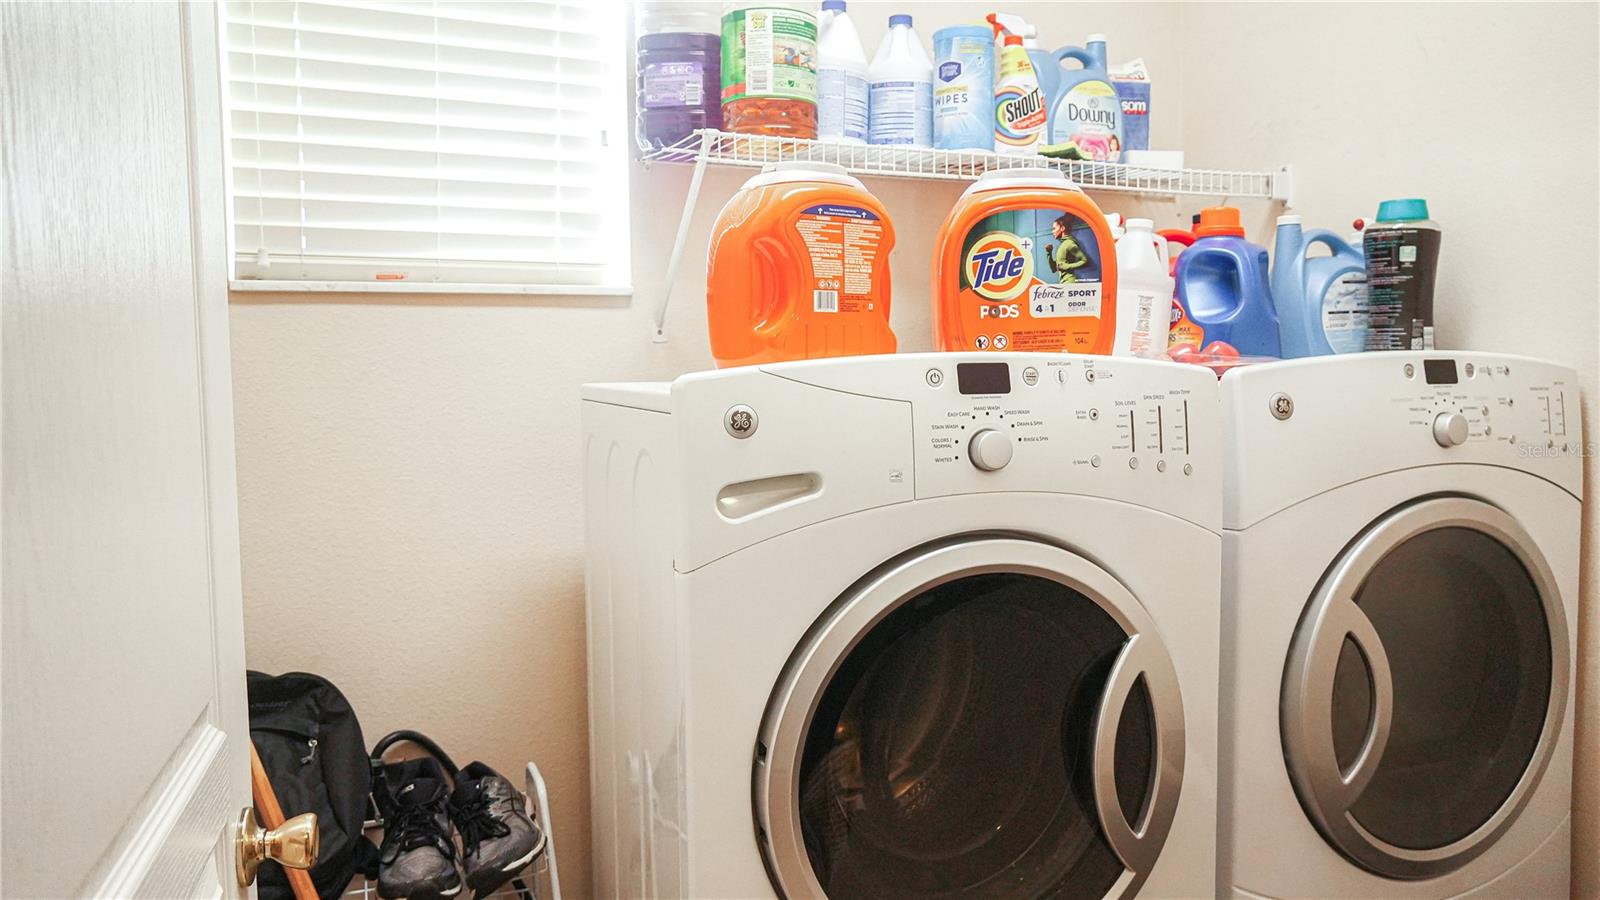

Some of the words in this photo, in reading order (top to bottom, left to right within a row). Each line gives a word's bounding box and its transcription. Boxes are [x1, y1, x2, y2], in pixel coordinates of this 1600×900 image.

[936, 92, 968, 106] WIPES
[1006, 88, 1040, 122] SHOUT
[1068, 103, 1115, 129] Downy
[972, 249, 1025, 289] Tide
[1033, 286, 1065, 301] febreze
[980, 304, 1020, 319] PODS
[1035, 304, 1043, 313] 4
[1050, 304, 1055, 312] 1
